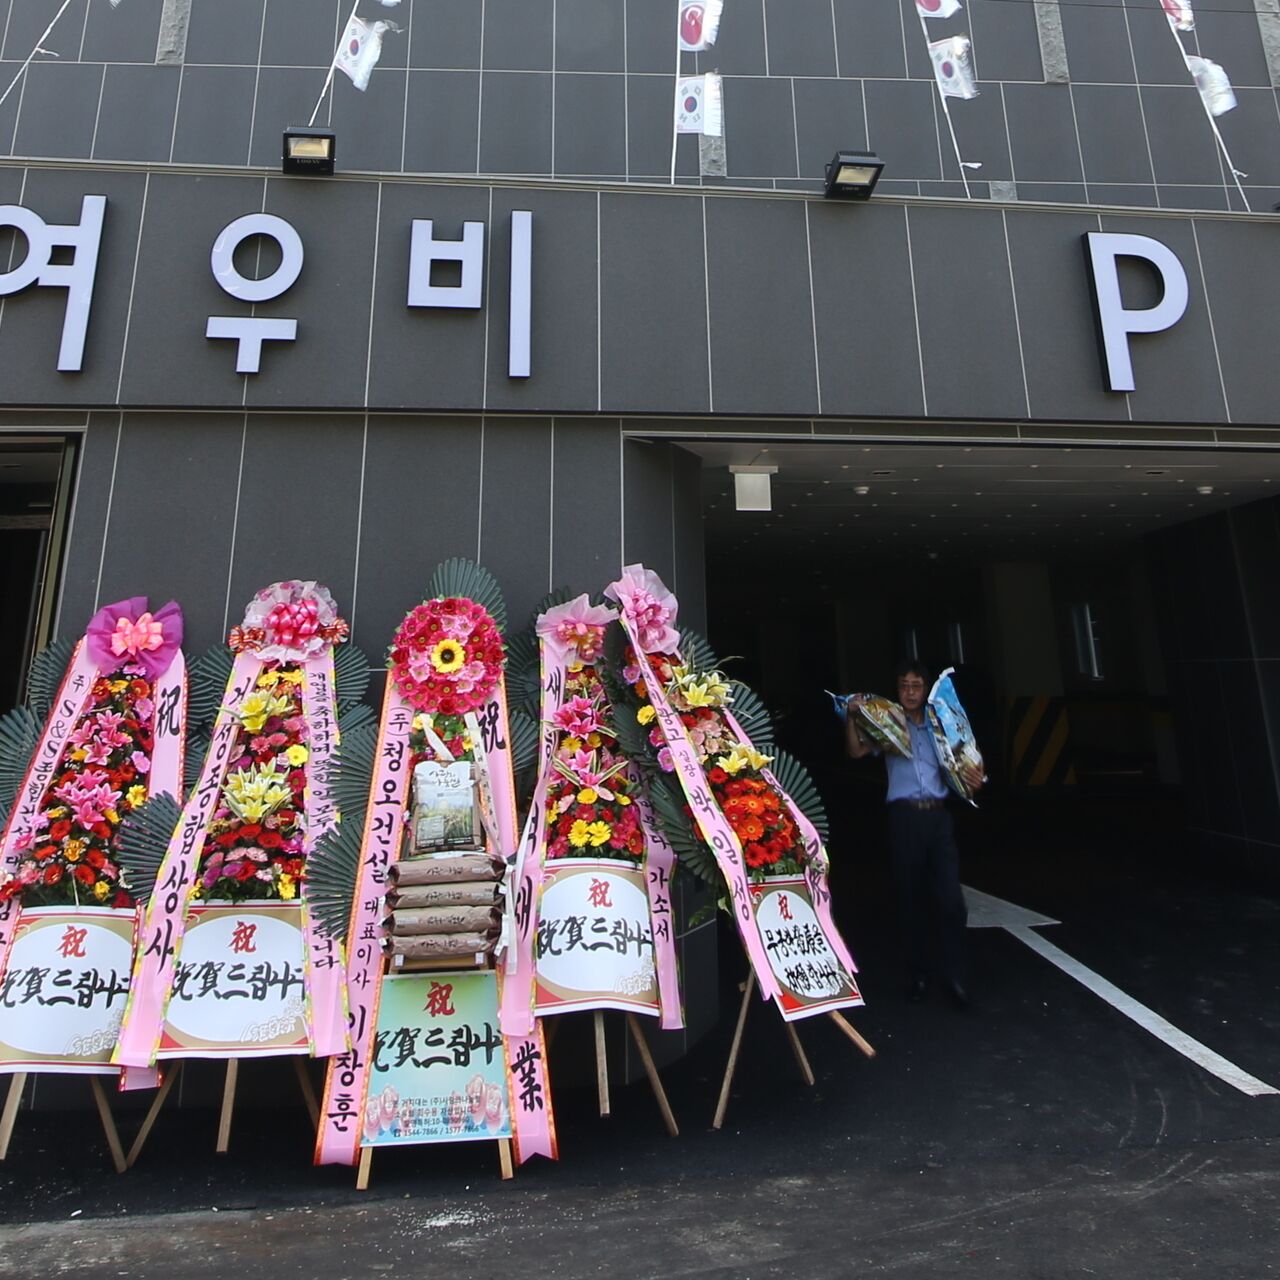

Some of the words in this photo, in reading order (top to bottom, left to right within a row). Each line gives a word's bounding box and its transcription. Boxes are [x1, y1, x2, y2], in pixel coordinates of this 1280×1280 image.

[1082, 231, 1189, 392] P
[156, 686, 181, 738] 祝
[477, 700, 507, 755] 祝
[586, 877, 613, 908] 祝
[56, 925, 89, 959] 祝
[228, 920, 258, 954] 祝
[423, 981, 455, 1018] 祝
[373, 1022, 503, 1072] 賀드립니
